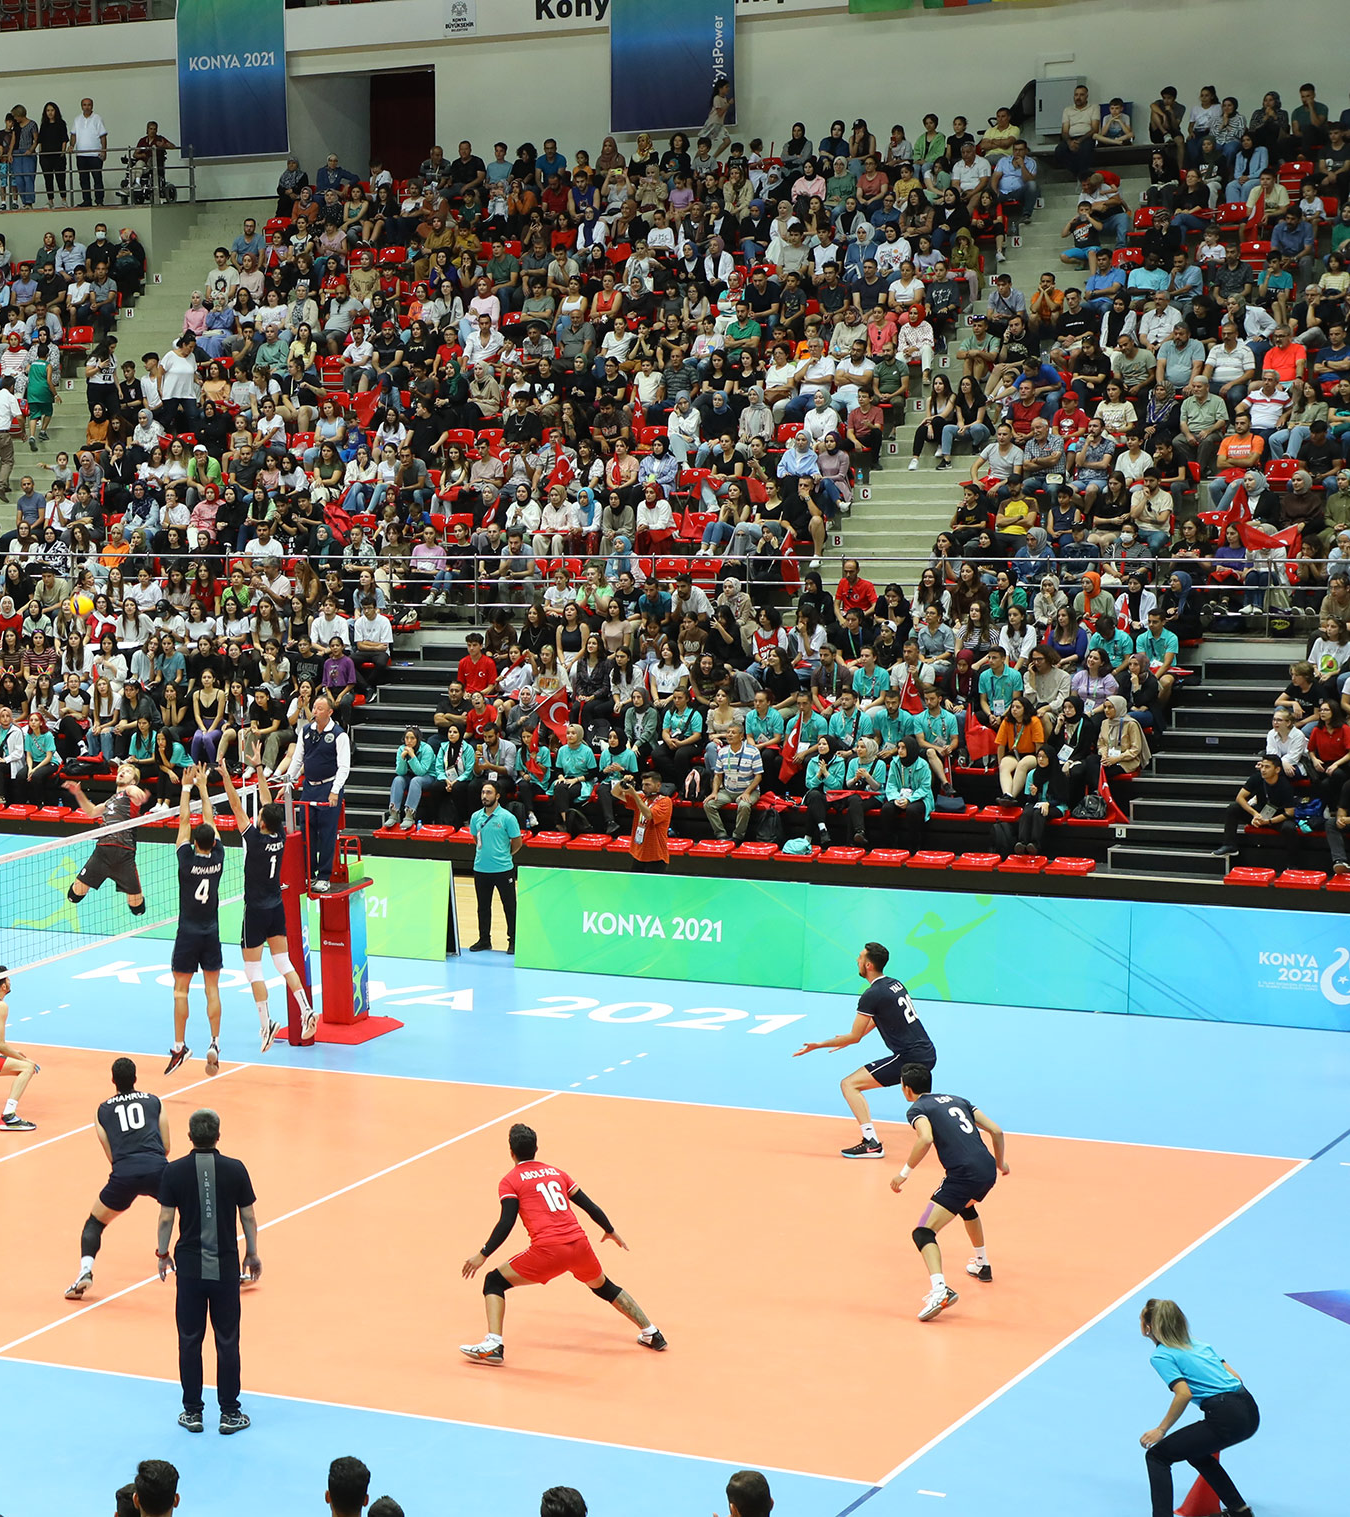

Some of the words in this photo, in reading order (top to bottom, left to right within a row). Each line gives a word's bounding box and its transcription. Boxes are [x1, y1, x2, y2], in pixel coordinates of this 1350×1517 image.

[189, 54, 241, 71] KONYA
[243, 51, 275, 68] 2021
[269, 855, 277, 879] 1
[194, 879, 210, 904] 4
[582, 911, 666, 939] KONYA
[671, 916, 722, 943] 2021
[1258, 951, 1319, 968] KONYA
[1278, 968, 1319, 983] 2021
[506, 996, 808, 1035] 2021
[114, 1102, 145, 1132] 10
[948, 1107, 974, 1134] 3
[520, 1167, 560, 1181] ABOLFAZL
[536, 1180, 568, 1212] 16
